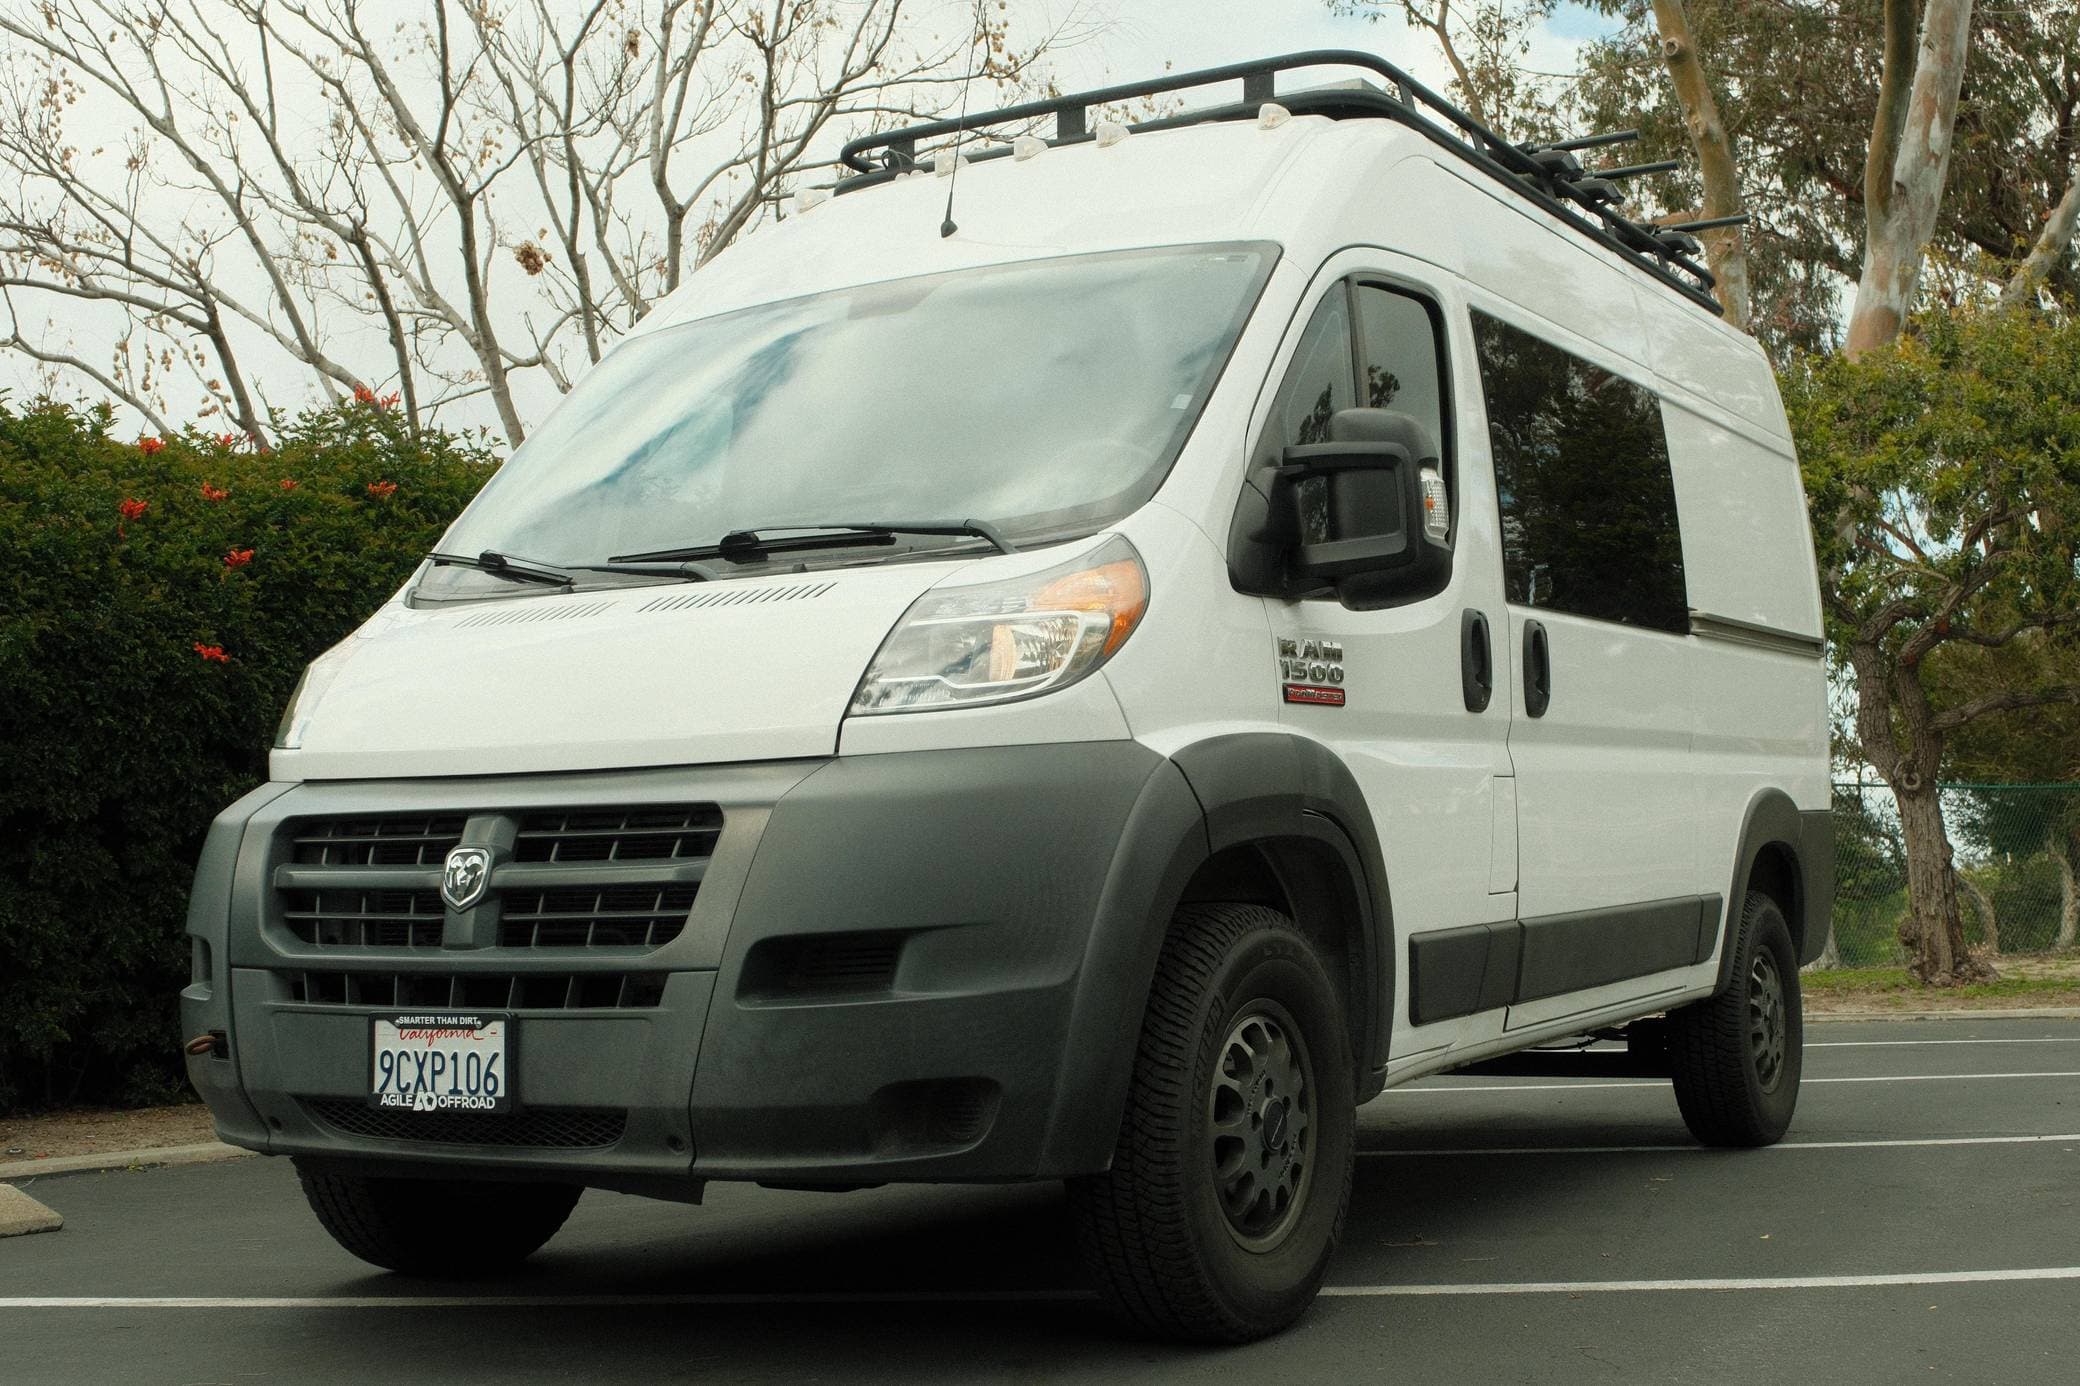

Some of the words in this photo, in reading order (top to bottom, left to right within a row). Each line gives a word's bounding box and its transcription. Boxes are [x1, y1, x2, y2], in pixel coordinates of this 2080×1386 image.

[1277, 636, 1343, 662] RAM
[1279, 659, 1344, 684] 1500
[398, 1016, 436, 1025] SMARTER
[437, 1016, 458, 1025] THAN
[459, 1017, 478, 1026] DIRT
[379, 1050, 499, 1096] 9CXP106
[380, 1094, 413, 1106] AGILE
[438, 1095, 496, 1109] OFFROAD
